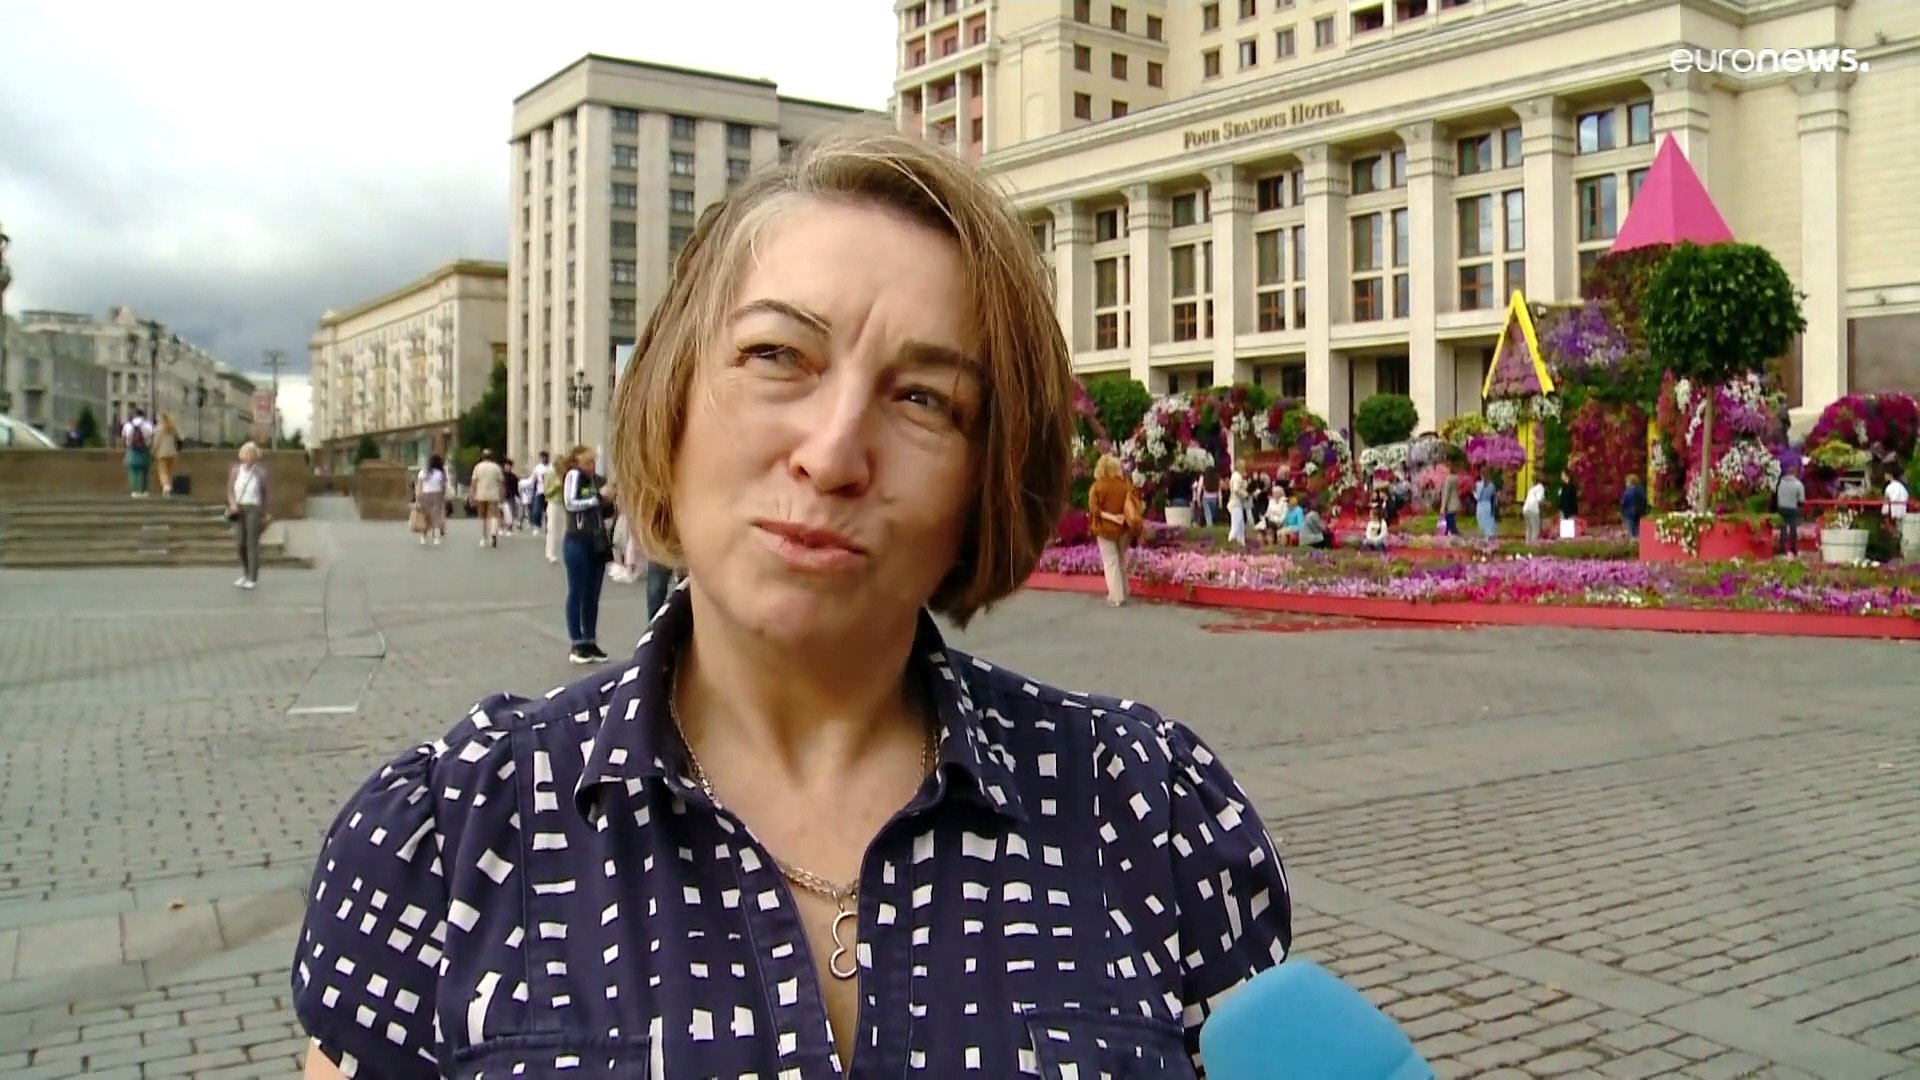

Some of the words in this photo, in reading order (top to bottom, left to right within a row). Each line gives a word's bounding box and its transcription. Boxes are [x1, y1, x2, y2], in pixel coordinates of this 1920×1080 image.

[1183, 128, 1220, 149] FOUR
[1223, 112, 1287, 140] SEASONS
[1291, 99, 1345, 125] HOTEL
